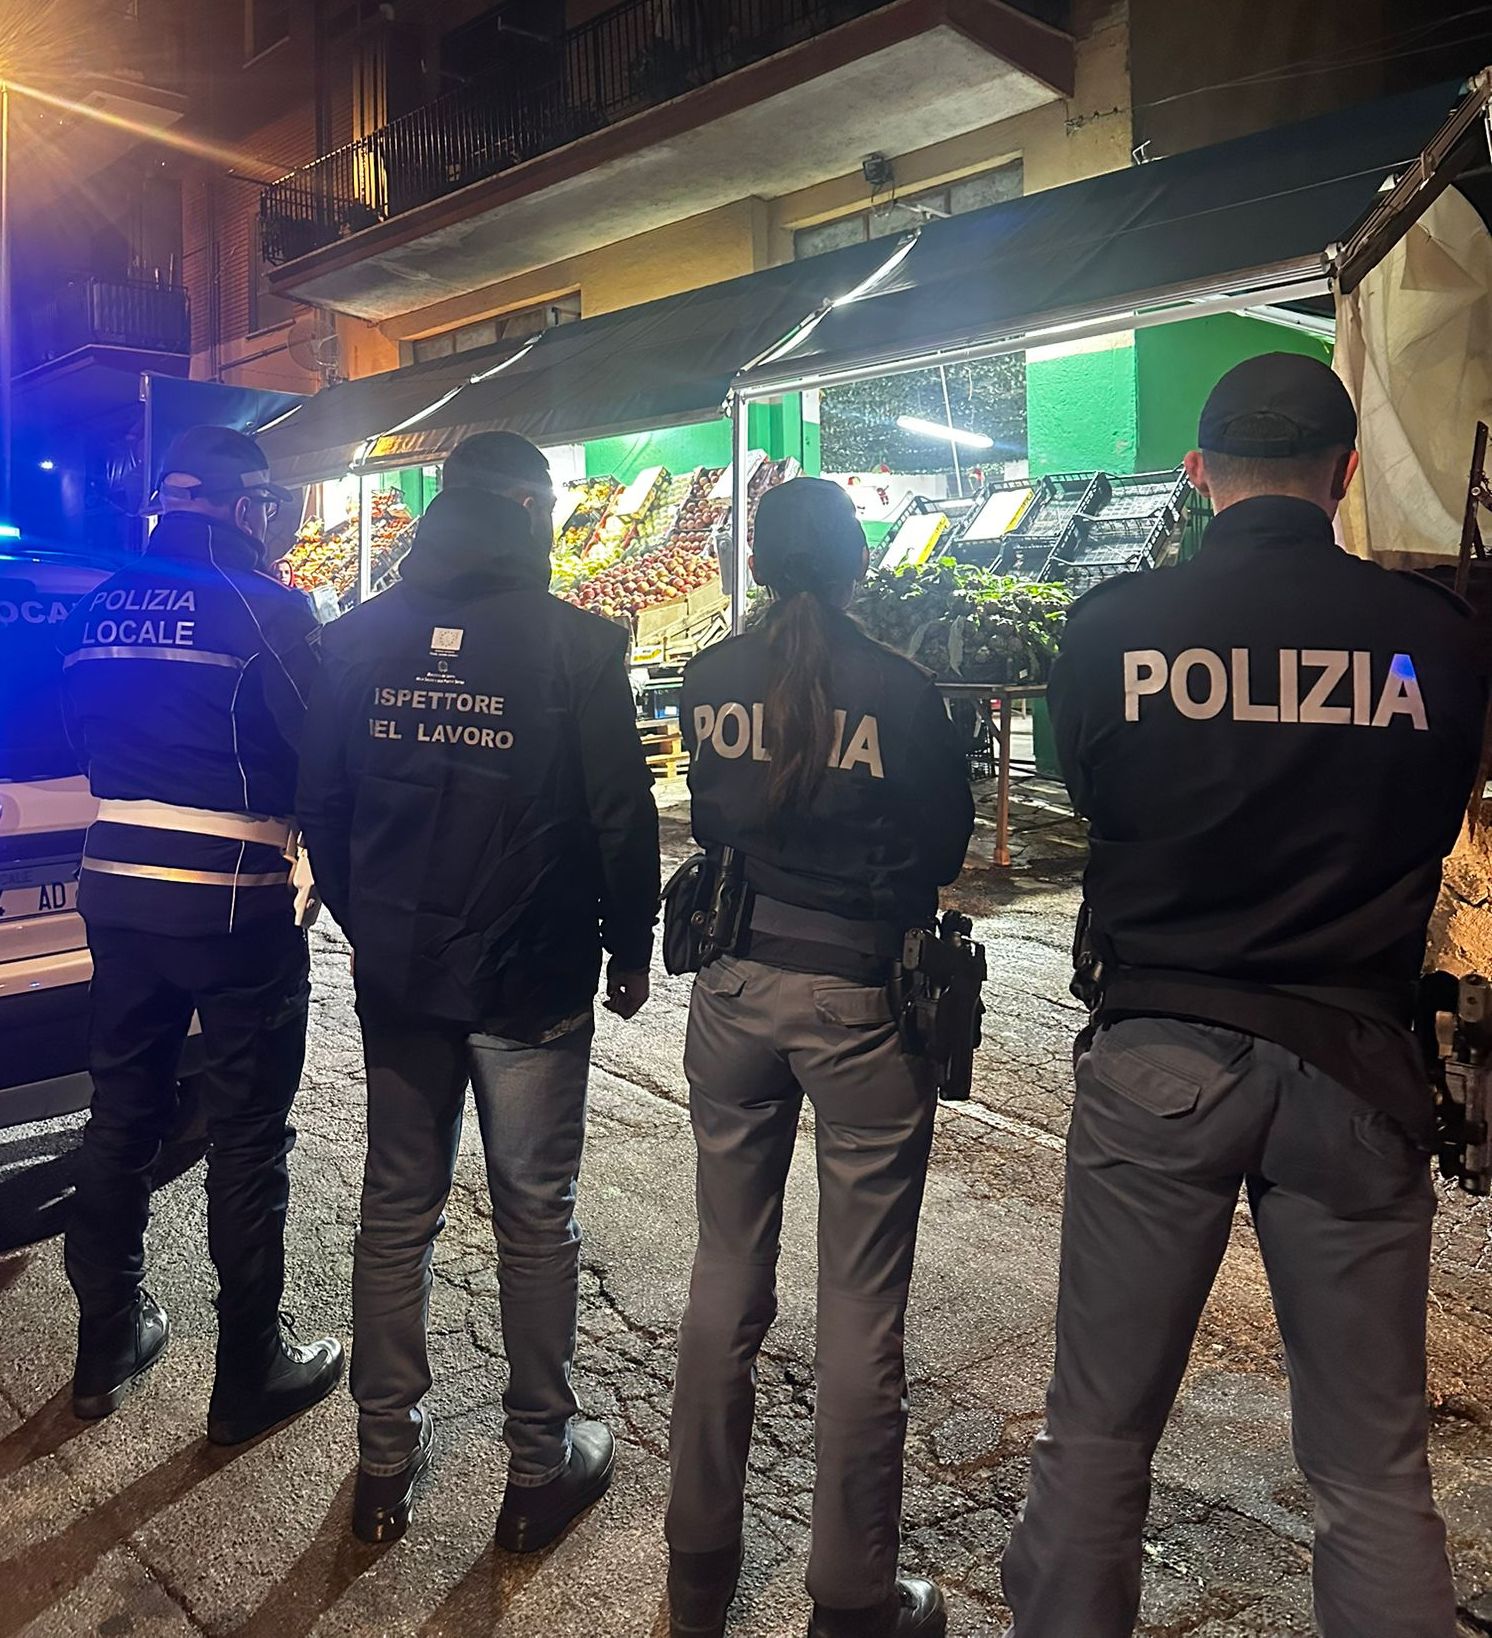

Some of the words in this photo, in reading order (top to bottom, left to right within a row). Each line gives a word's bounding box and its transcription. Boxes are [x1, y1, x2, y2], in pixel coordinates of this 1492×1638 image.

[88, 588, 196, 612] POLIZIA
[82, 620, 196, 646] LOCALE
[374, 687, 505, 715] ISPETTORE
[1123, 647, 1429, 731] POLIZIA
[369, 718, 402, 740] EL
[417, 722, 514, 749] LAVORO
[693, 701, 885, 779] POLIA
[39, 881, 67, 911] AD
